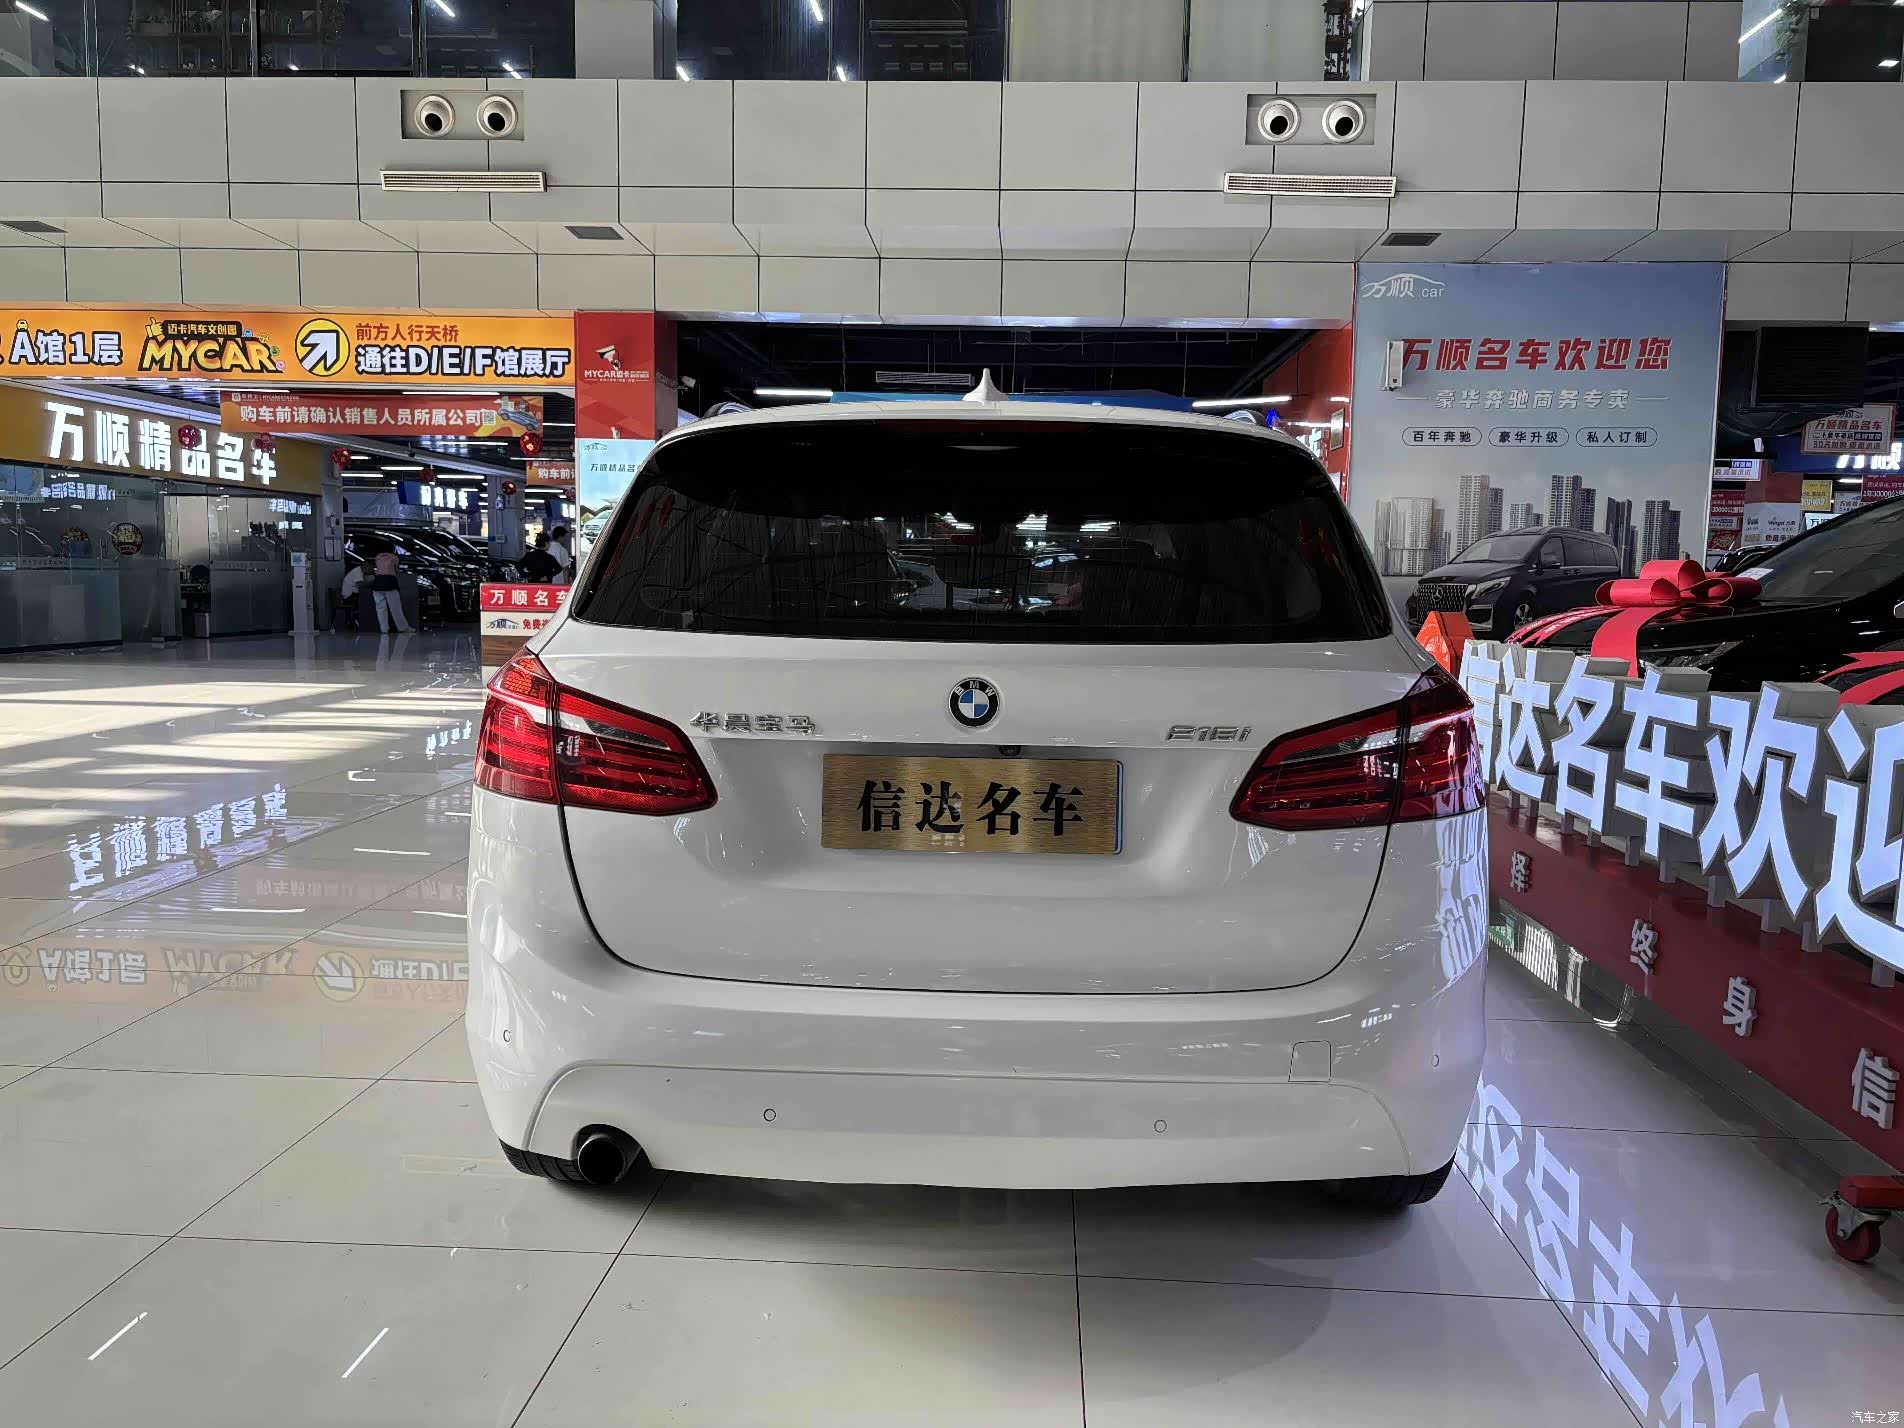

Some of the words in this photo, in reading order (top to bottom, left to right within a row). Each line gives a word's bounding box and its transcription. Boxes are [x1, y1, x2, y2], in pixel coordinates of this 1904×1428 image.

[1421, 288, 1444, 297] car
[355, 323, 460, 343] 前方人行天桥
[10, 329, 123, 366] A馆1层
[139, 337, 282, 373] MYCAR
[1402, 337, 1674, 372] 万顺名车欢迎您
[355, 345, 570, 376] 通往D/E/F馆展厅
[1434, 389, 1632, 410] 豪华奔驰商务专卖
[240, 405, 483, 427] 购车前请确认销售人员所属公司
[1814, 419, 1883, 430] 万顺精品名车
[44, 401, 278, 486] 万顺精品名车
[1412, 430, 1472, 443] 百年奔驰
[1498, 430, 1559, 444] 豪华升级
[1586, 430, 1648, 444] 私人订制
[590, 463, 642, 473] 万顺精品名
[489, 589, 569, 606] 万顺名车
[954, 680, 996, 697] BMW
[690, 711, 816, 736] 华晨宝马
[856, 779, 1084, 836] 信达名车
